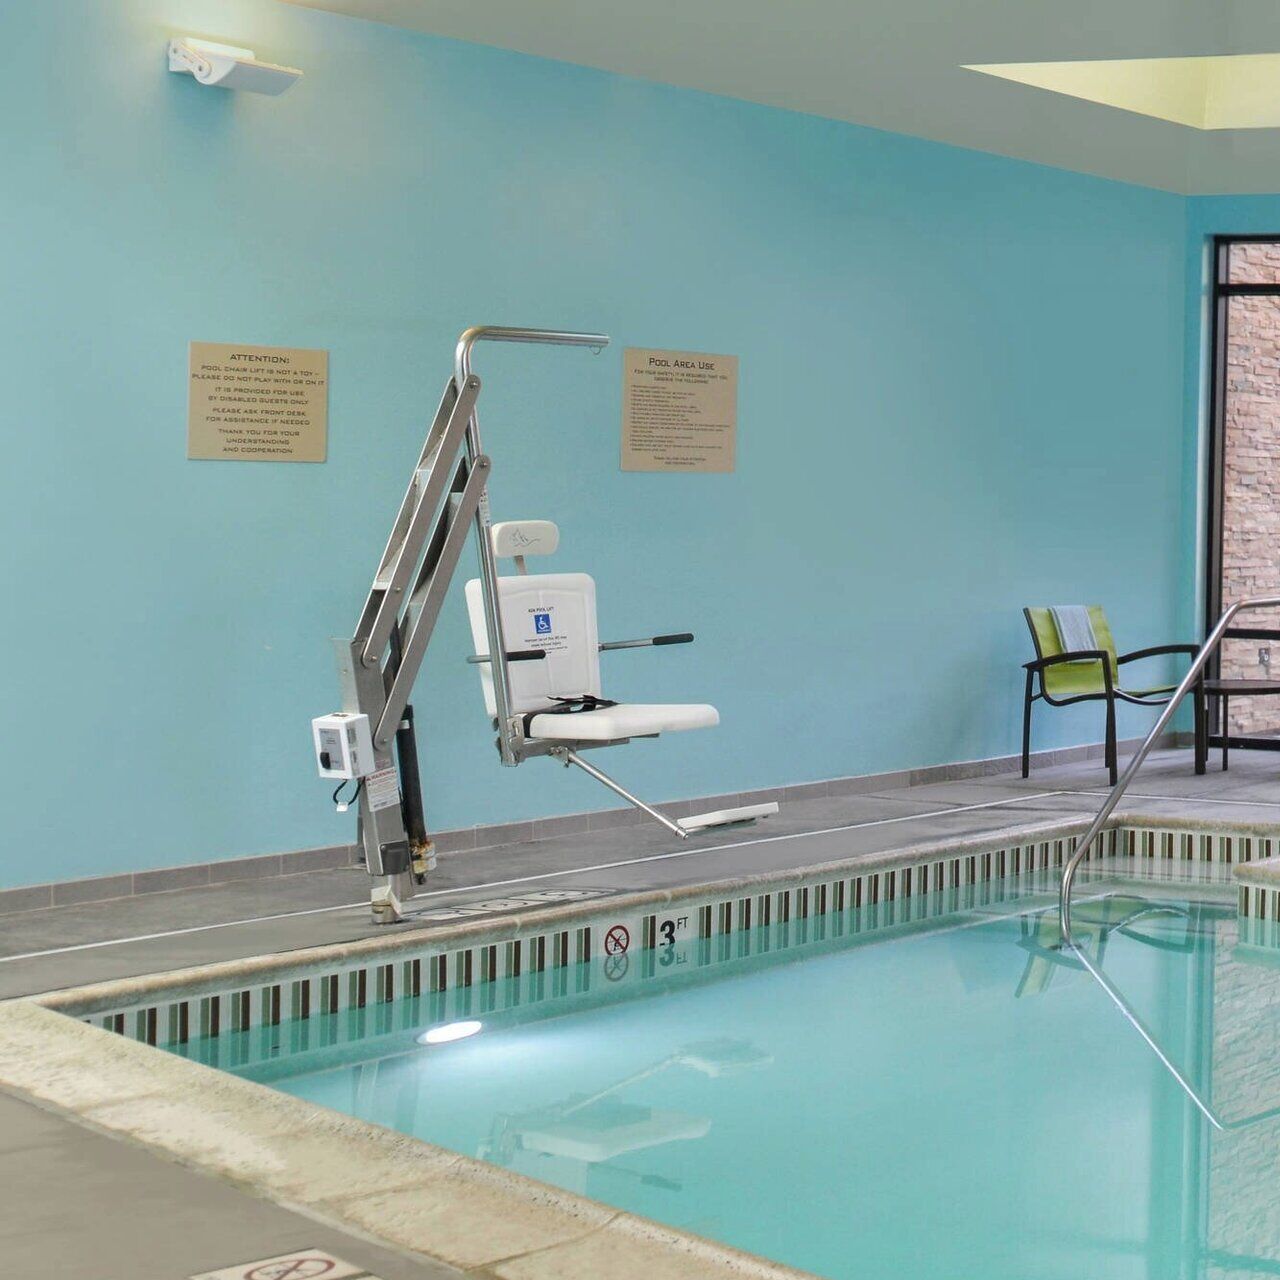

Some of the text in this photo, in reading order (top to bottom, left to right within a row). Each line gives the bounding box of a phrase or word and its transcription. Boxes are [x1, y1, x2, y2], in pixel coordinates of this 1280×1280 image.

[230, 354, 290, 364] ATTENTION:
[649, 357, 715, 370] POOL AREA USE
[659, 917, 688, 945] 3 FT
